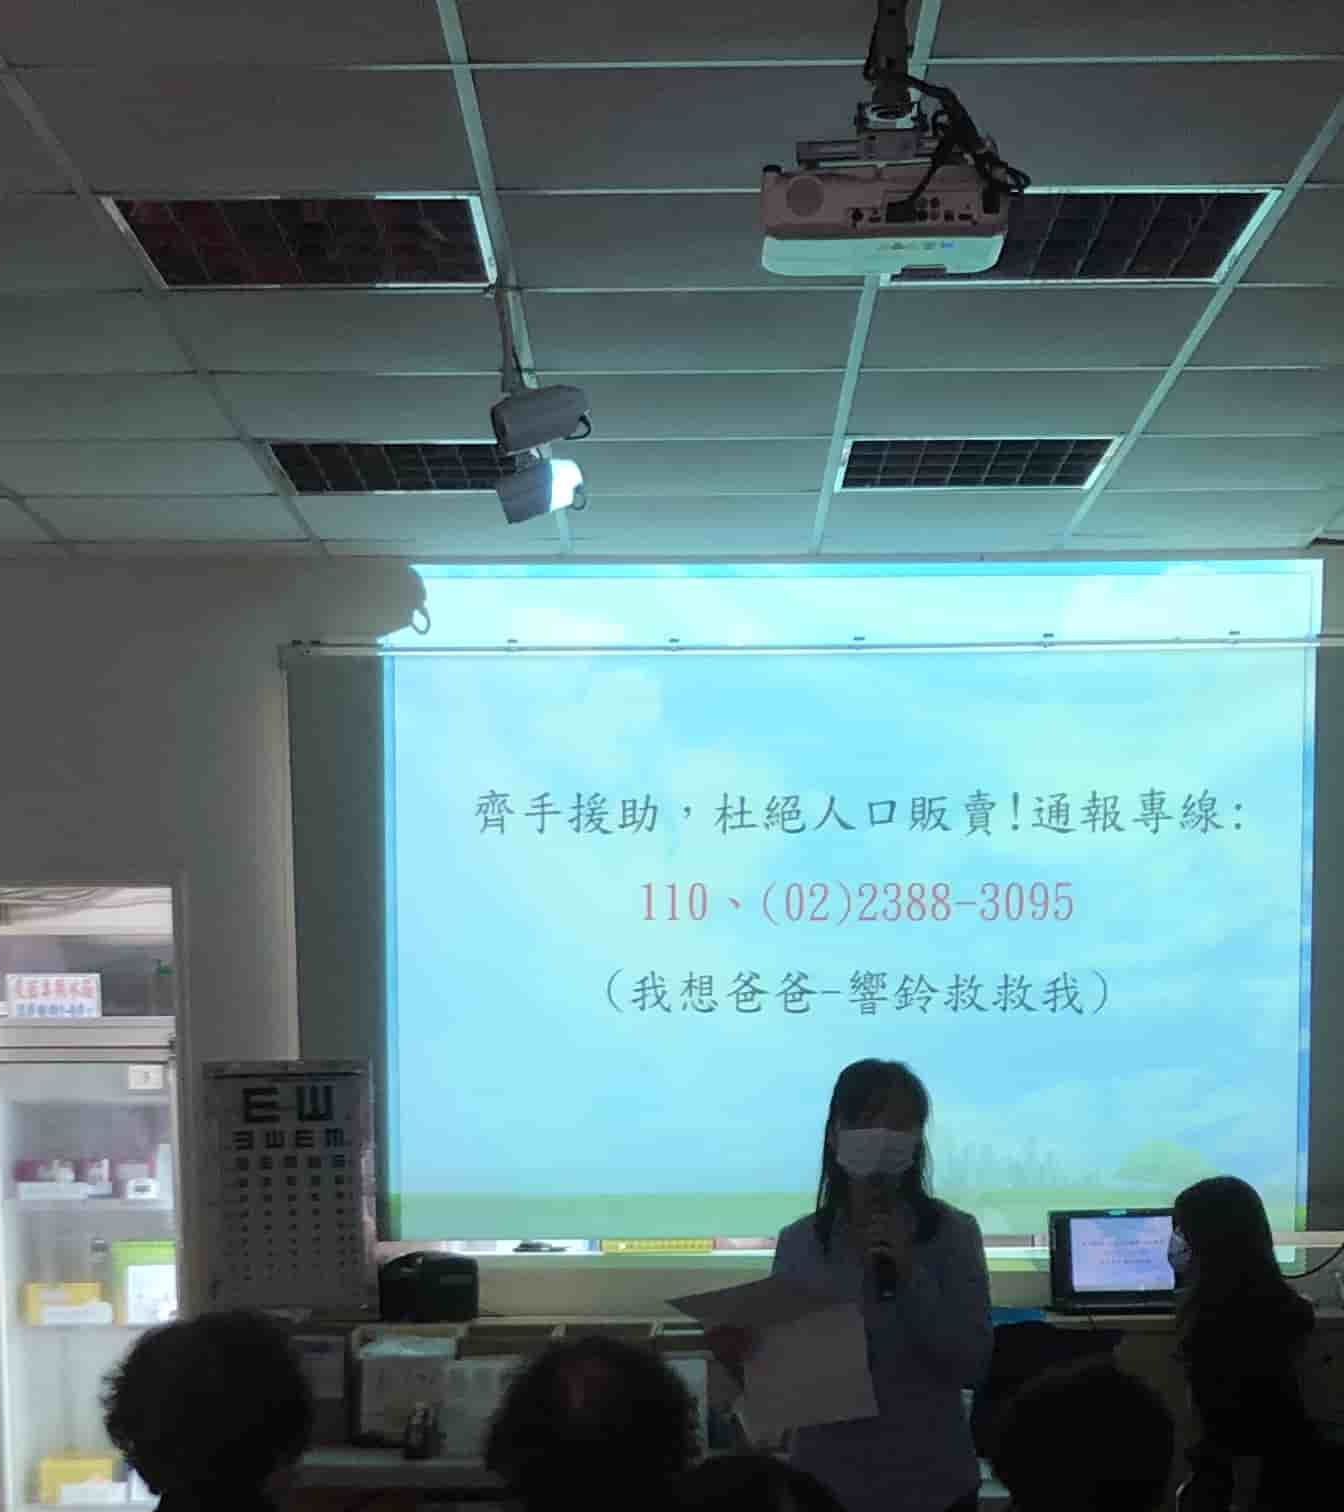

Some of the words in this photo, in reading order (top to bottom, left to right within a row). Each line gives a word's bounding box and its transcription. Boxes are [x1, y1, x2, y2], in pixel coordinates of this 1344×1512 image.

[639, 878, 1074, 927] 110、(02)2388-3095
[606, 967, 1109, 1016] (我想爸爸-響鈴救救我)
